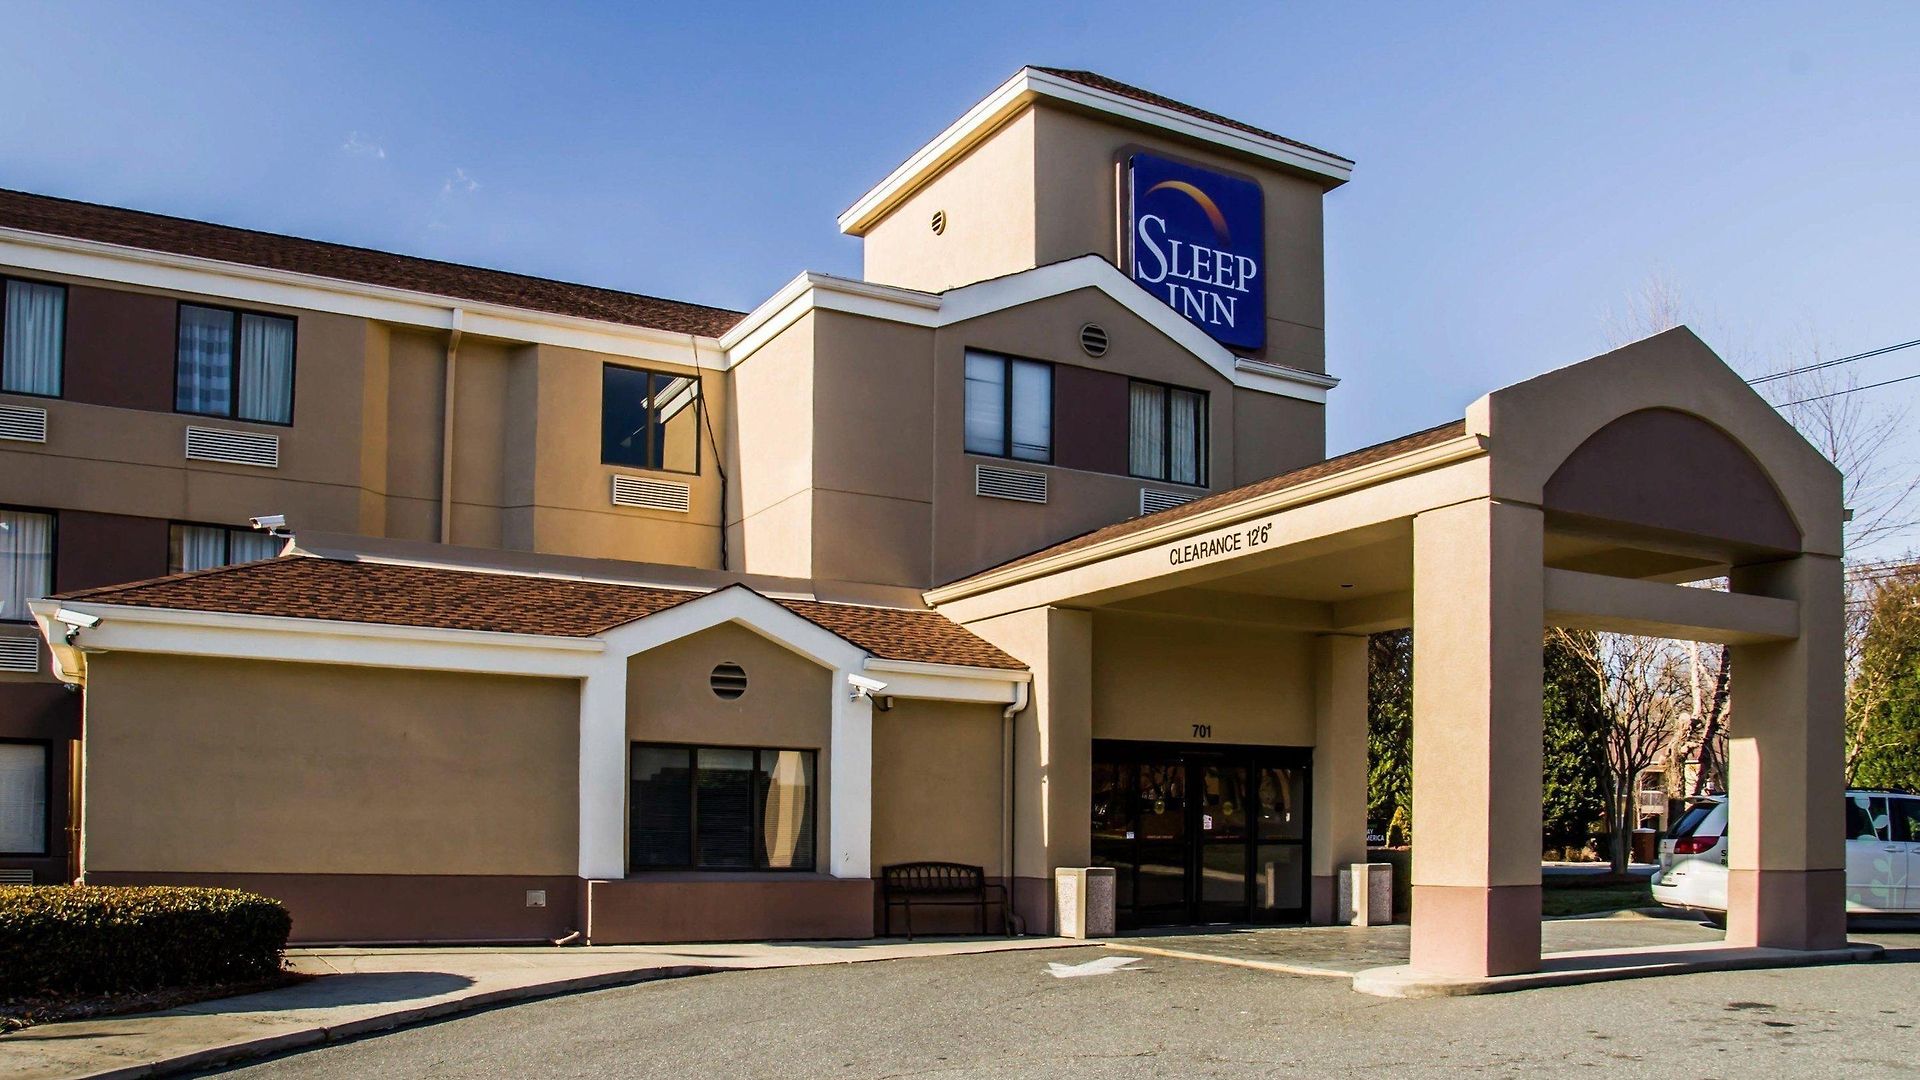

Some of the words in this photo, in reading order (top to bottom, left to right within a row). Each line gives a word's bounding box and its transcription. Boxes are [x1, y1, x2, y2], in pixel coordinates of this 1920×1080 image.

[1138, 214, 1257, 292] SLEEP
[1166, 282, 1237, 328] INN
[1169, 532, 1242, 566] CLEARANCE
[1192, 724, 1211, 738] 701
